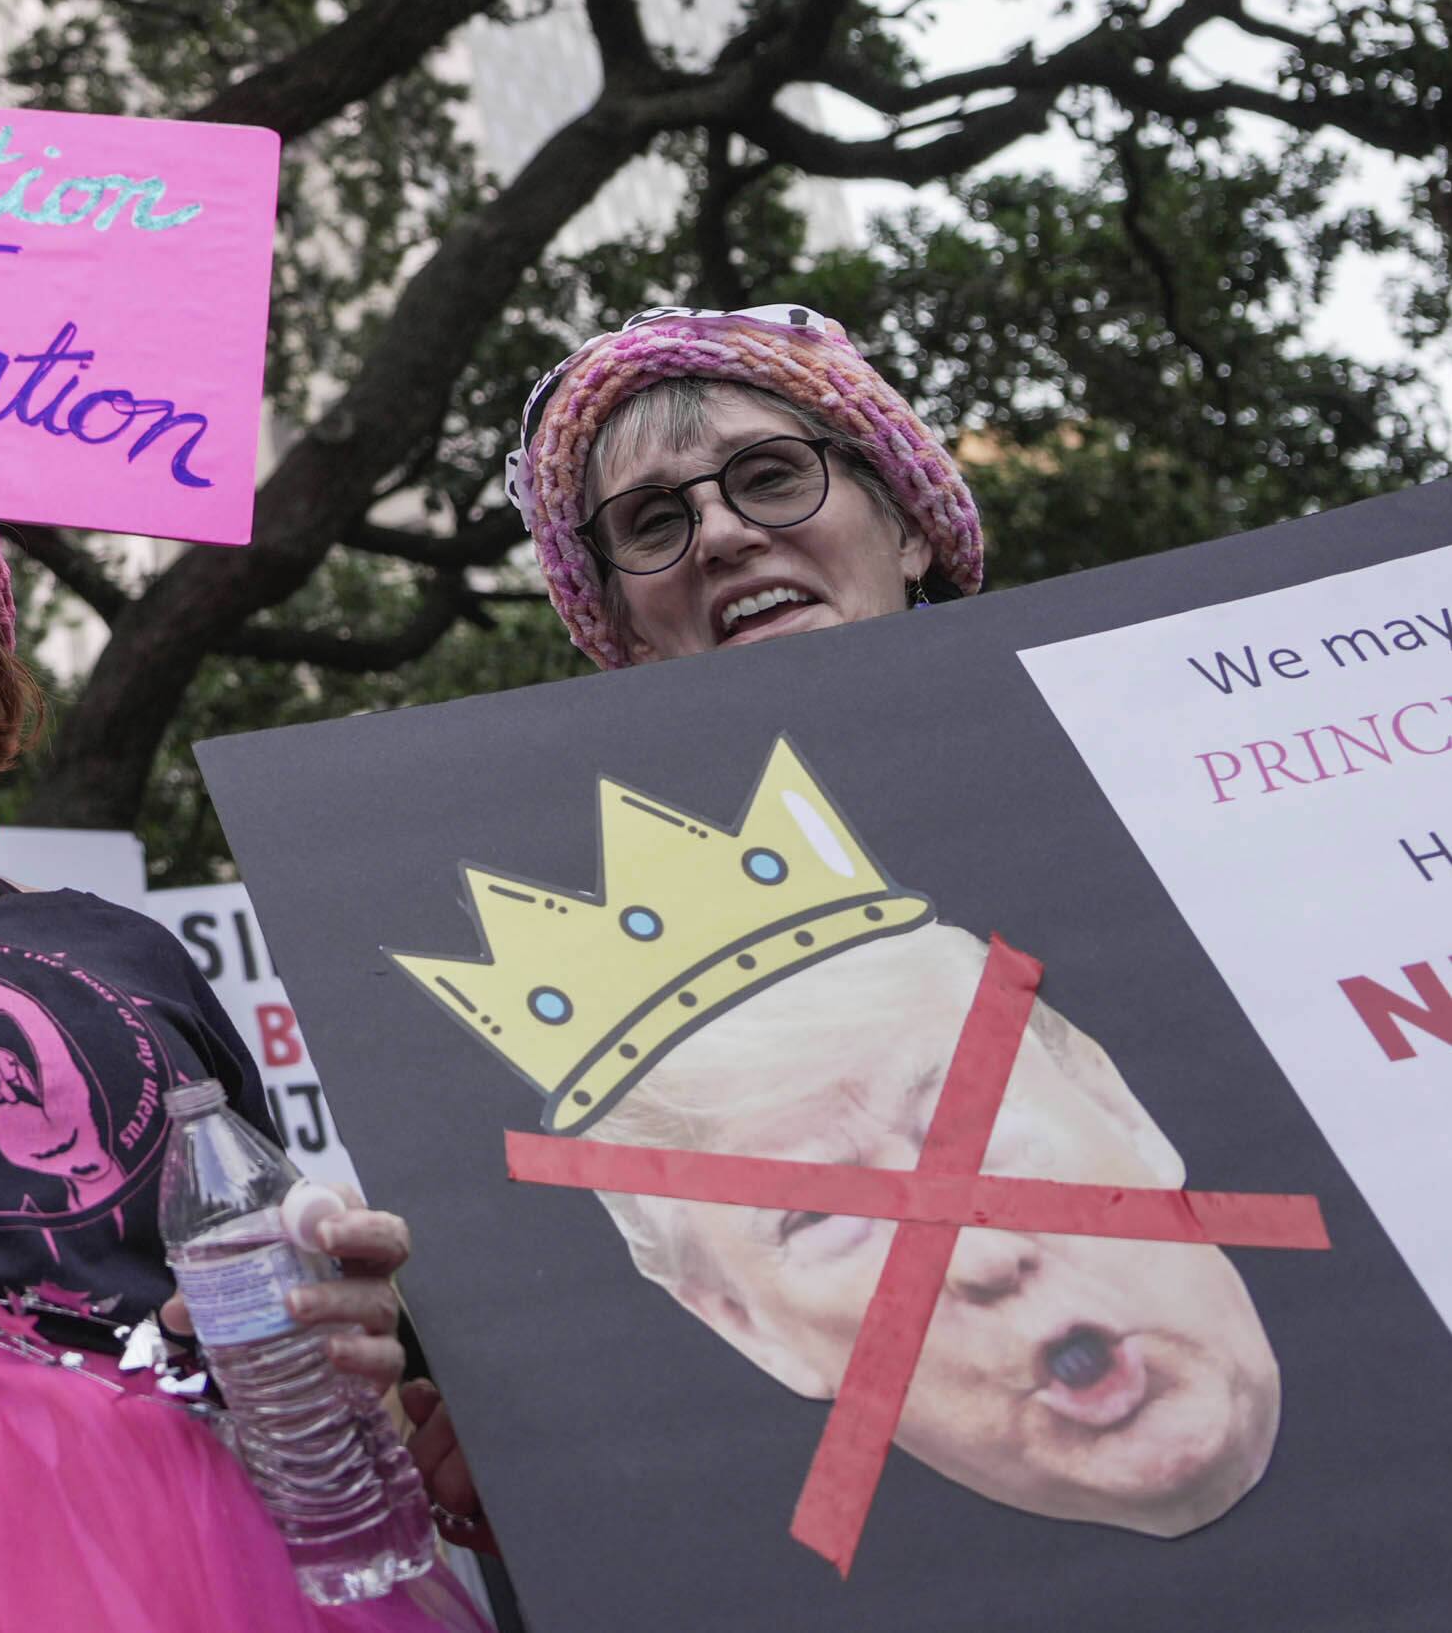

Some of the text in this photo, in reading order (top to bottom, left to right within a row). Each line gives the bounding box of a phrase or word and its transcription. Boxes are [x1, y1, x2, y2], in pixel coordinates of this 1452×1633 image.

[1186, 644, 1310, 695] We
[1194, 695, 1452, 804] PRINC
[1336, 955, 1452, 1062] N
